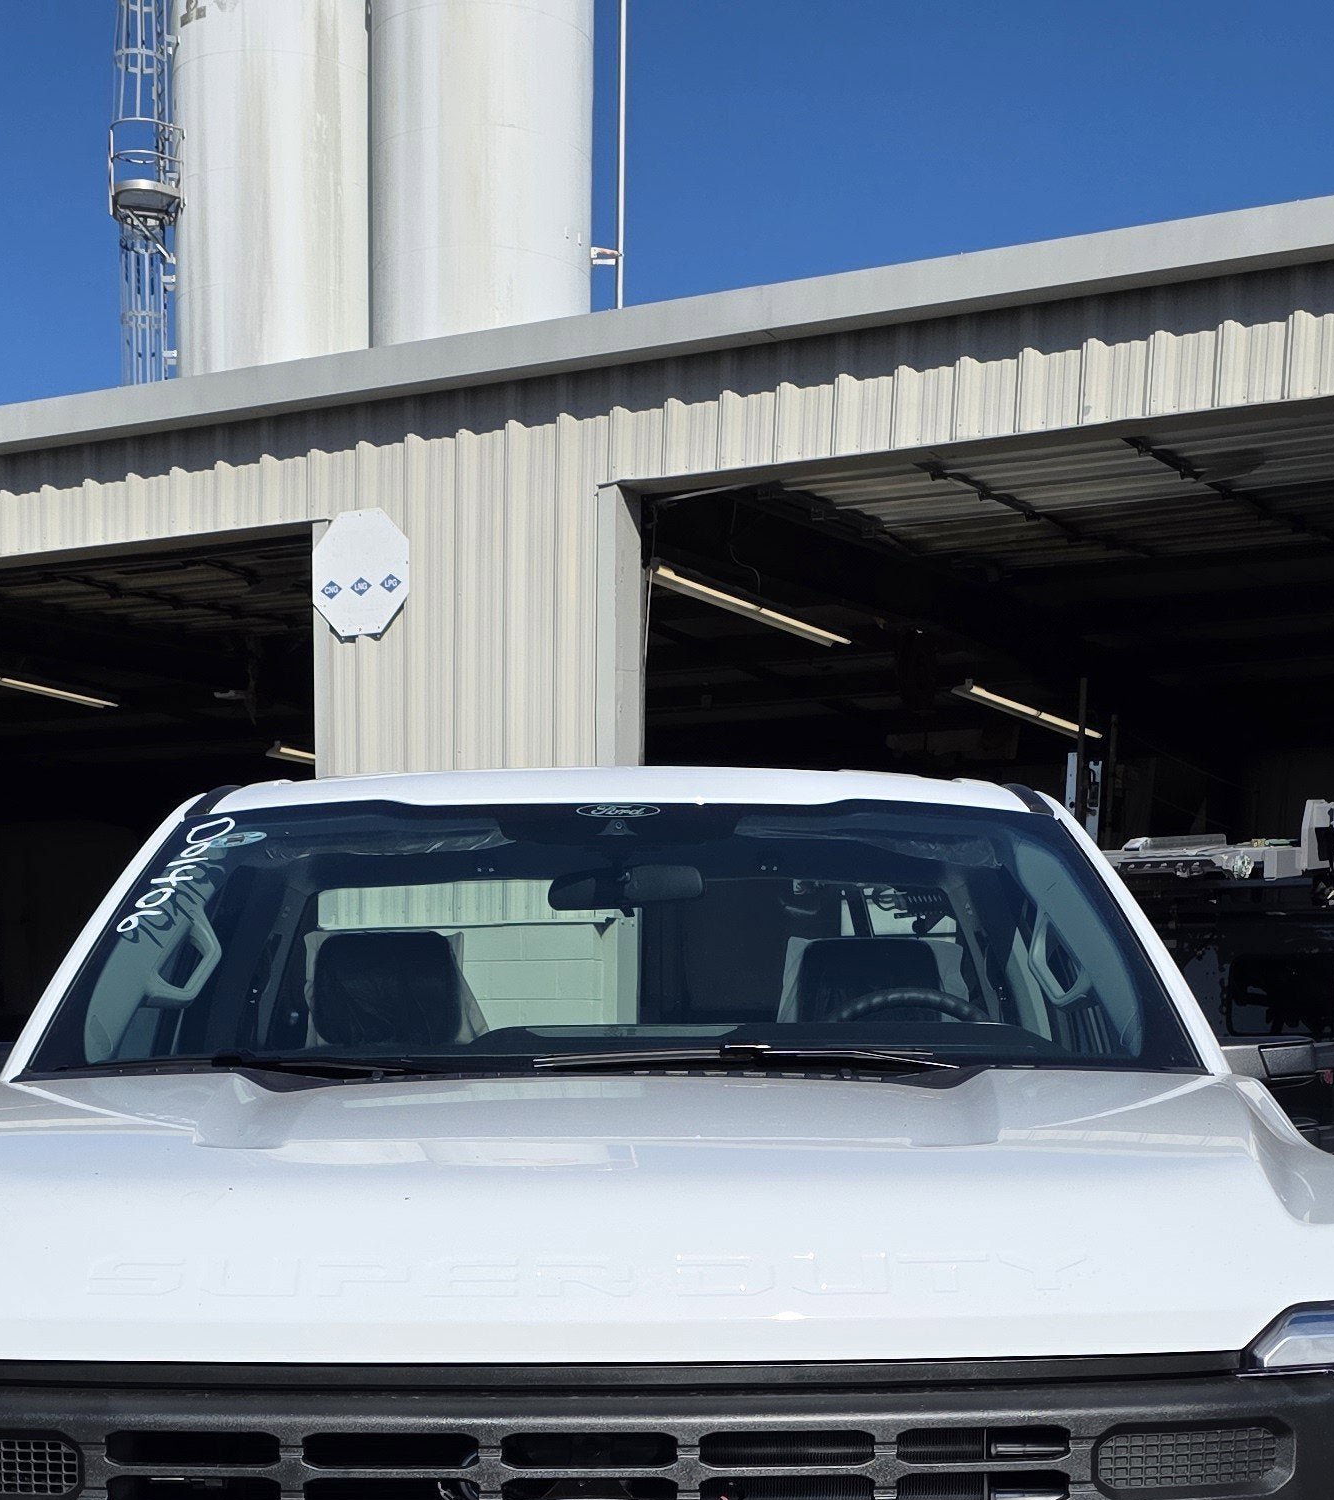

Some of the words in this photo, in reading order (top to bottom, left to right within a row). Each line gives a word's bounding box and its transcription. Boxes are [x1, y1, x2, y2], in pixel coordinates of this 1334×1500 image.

[591, 804, 646, 816] Ford
[85, 1256, 635, 1298] SUPER
[674, 1253, 1089, 1297] DUTY
